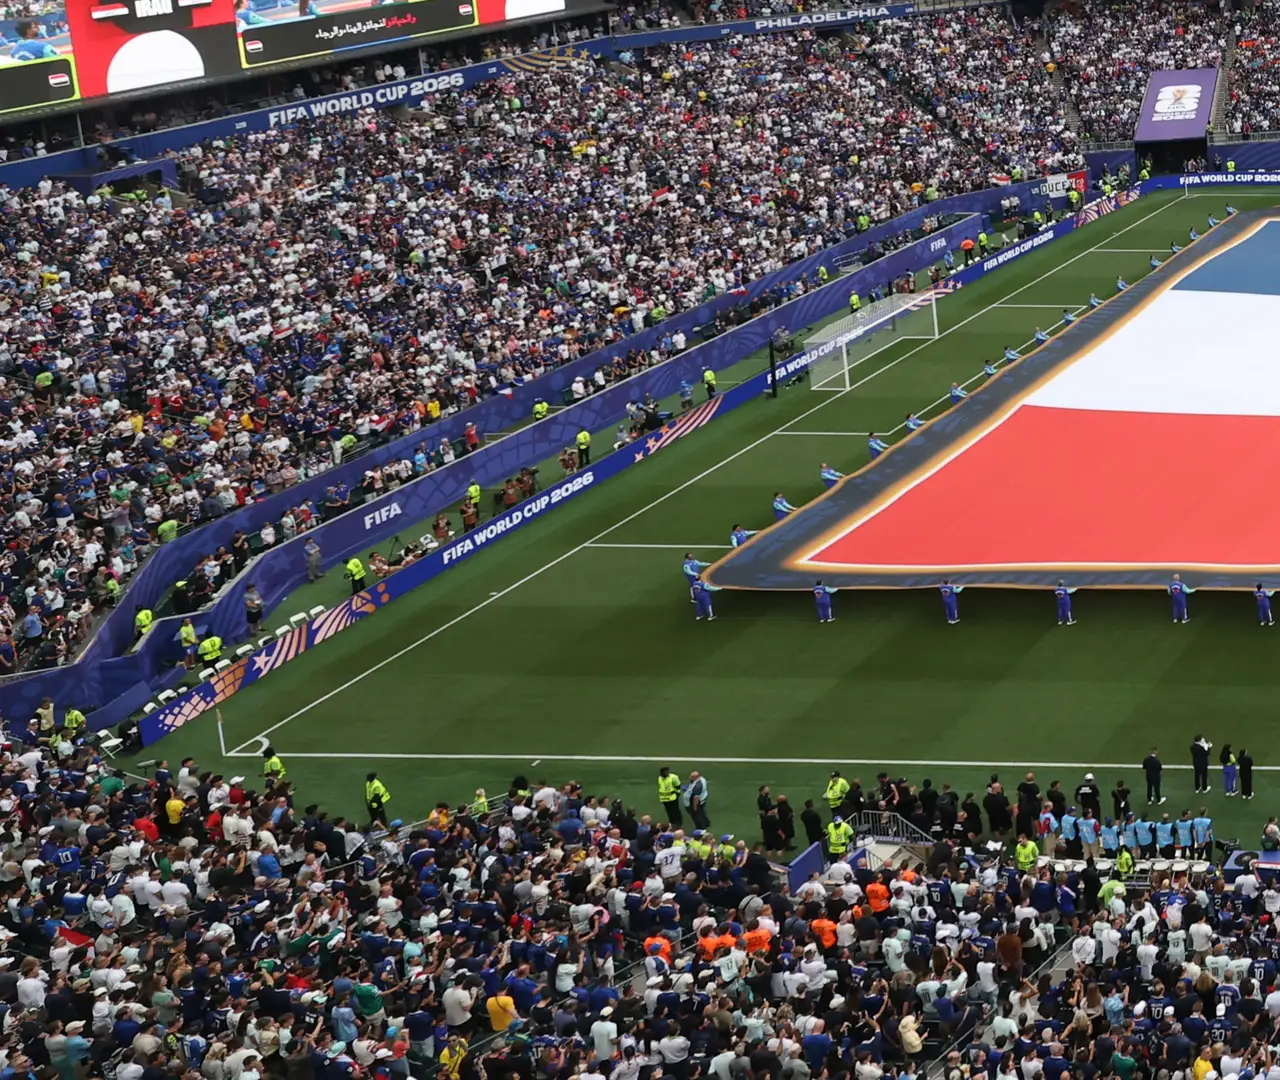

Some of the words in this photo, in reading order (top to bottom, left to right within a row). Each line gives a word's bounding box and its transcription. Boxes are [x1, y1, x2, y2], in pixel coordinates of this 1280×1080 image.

[755, 6, 890, 30] PHILADELPHIA
[269, 108, 307, 126] FIFA
[310, 92, 374, 119] WORLD
[375, 84, 408, 104] CUP
[410, 73, 465, 96] 2026
[1180, 175, 1200, 185] FIFA
[1202, 174, 1234, 182] WORLD
[1236, 174, 1253, 182] CUP
[930, 238, 946, 252] FIFA
[984, 258, 998, 271] FIFA
[1000, 246, 1020, 263] WORLD
[1020, 240, 1033, 251] CUP
[1033, 230, 1054, 247] 2026
[364, 502, 402, 530] FIFA
[442, 542, 474, 564] FIFA
[474, 514, 522, 547] WORLD
[524, 497, 550, 518] CUP
[550, 472, 594, 504] 2026
[58, 852, 72, 864] 10
[1255, 968, 1264, 980] 10
[1151, 1007, 1162, 1019] 10
[1211, 1030, 1225, 1041] 20
